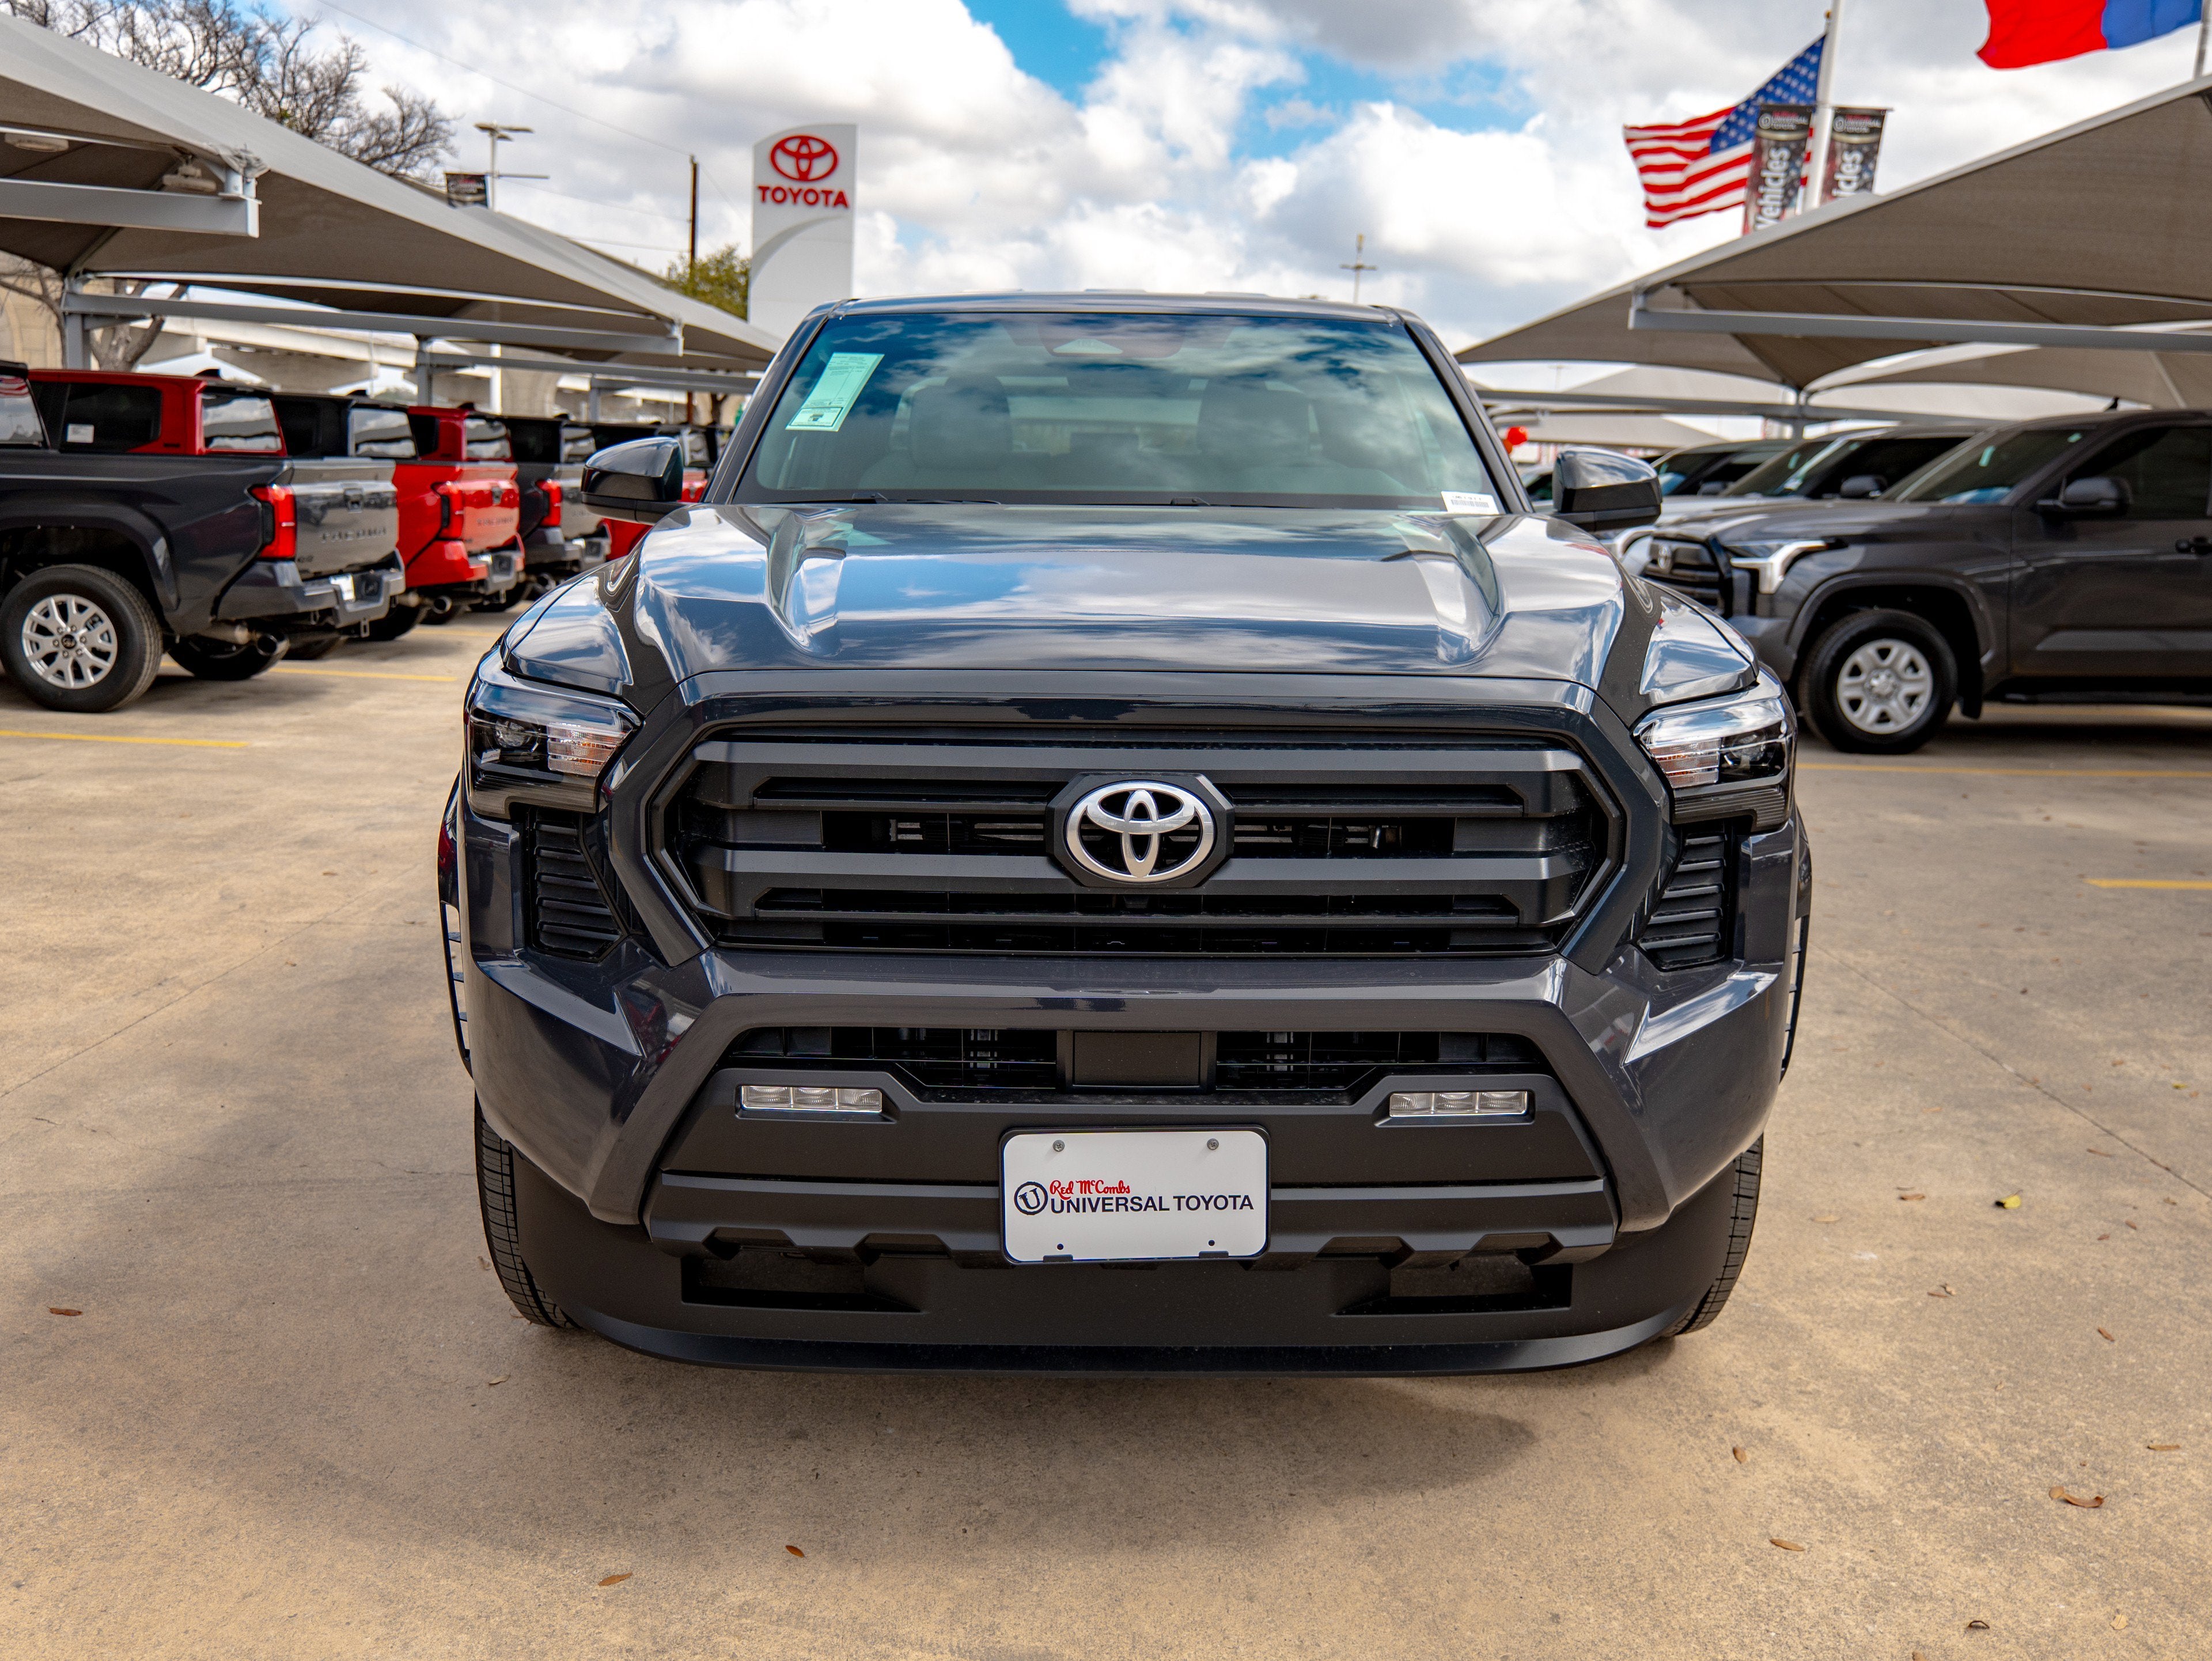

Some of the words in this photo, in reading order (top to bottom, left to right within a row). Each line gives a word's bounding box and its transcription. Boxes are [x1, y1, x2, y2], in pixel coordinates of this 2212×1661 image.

[757, 186, 849, 209] TOYOTA
[1050, 1180, 1074, 1200] Red
[1075, 1180, 1131, 1195] McCombs
[1051, 1195, 1170, 1214] UNIVERSAL
[1173, 1195, 1254, 1211] TOYOTA
